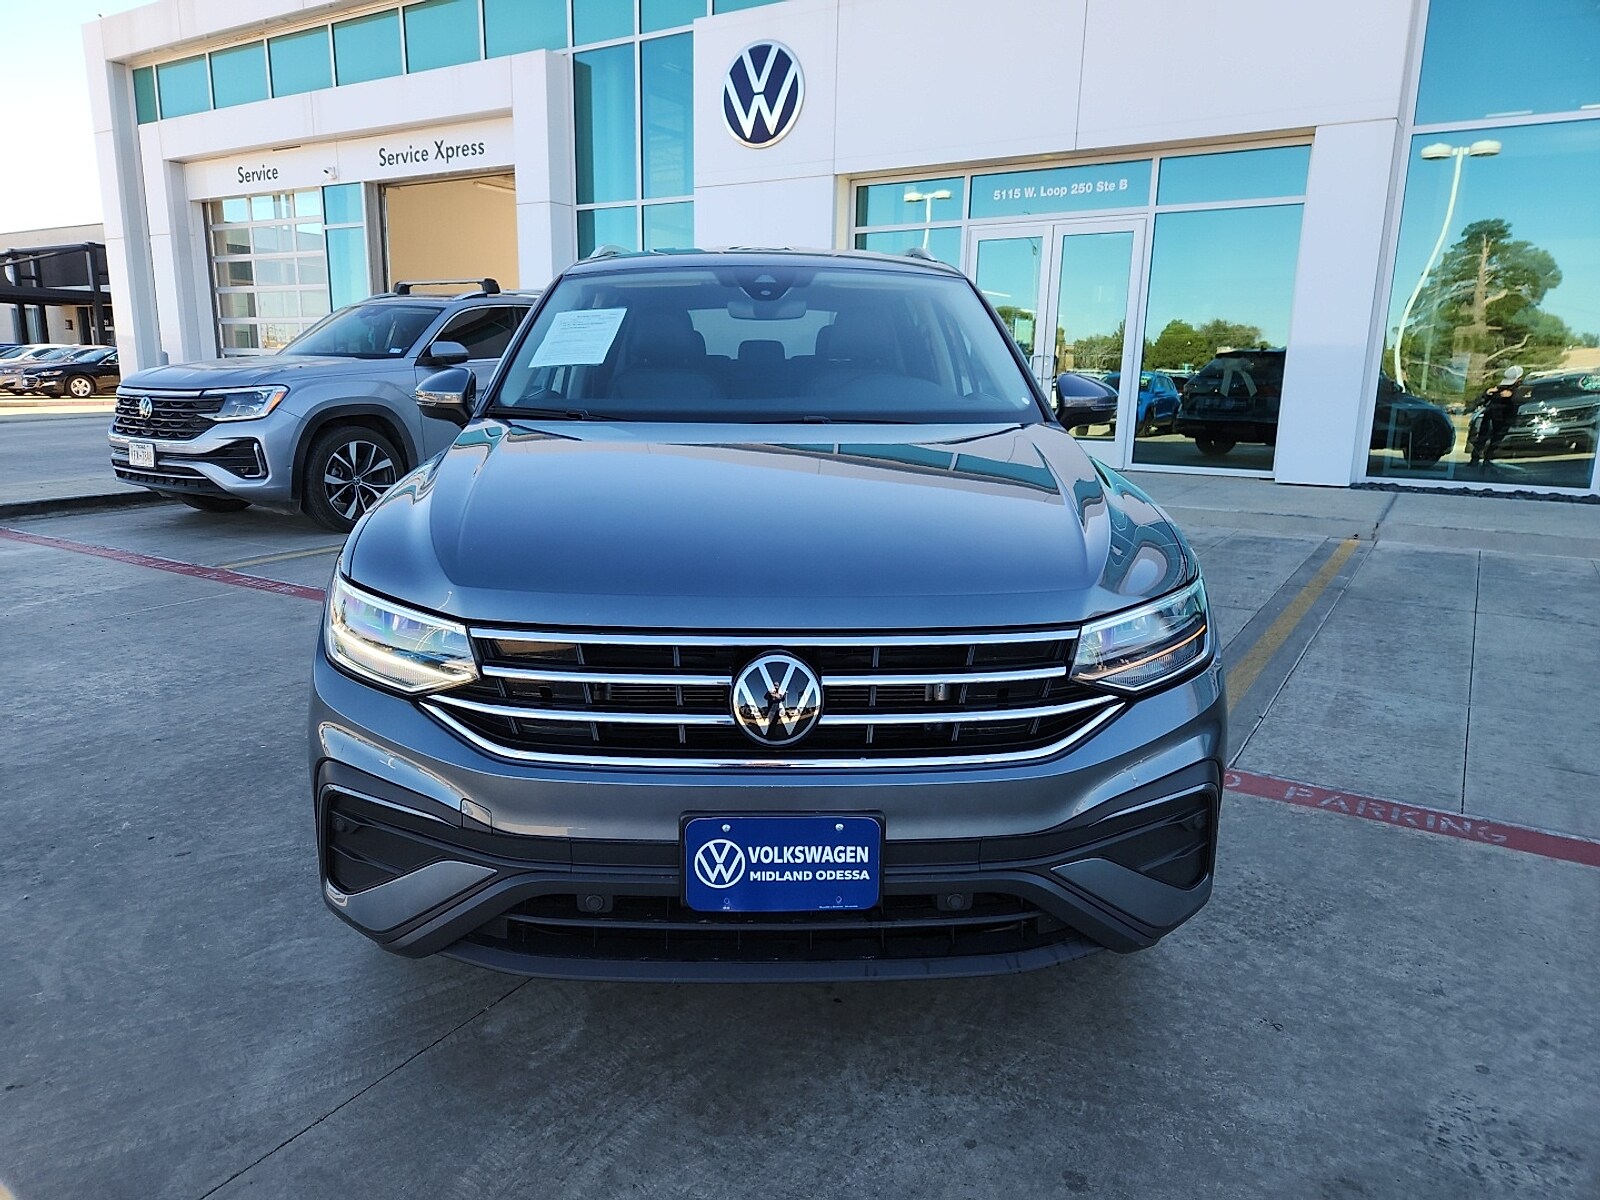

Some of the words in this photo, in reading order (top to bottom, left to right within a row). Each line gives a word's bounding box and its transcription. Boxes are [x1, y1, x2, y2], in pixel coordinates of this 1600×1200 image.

[722, 40, 804, 148] VW
[378, 145, 429, 167] Service
[433, 140, 485, 164] Xpress
[237, 164, 279, 184] Service
[993, 188, 1021, 200] 5115
[1024, 187, 1036, 198] W.
[1040, 185, 1067, 197] Loop
[1071, 182, 1093, 194] 250
[1096, 180, 1116, 193] Ste
[1119, 179, 1128, 190] B
[733, 655, 821, 744] VW
[1284, 786, 1508, 843] PARKING
[694, 838, 746, 889] VW
[748, 846, 869, 864] VOLKSWAGEN
[749, 870, 813, 881] MIDLAND
[815, 870, 870, 881] ODESSA
